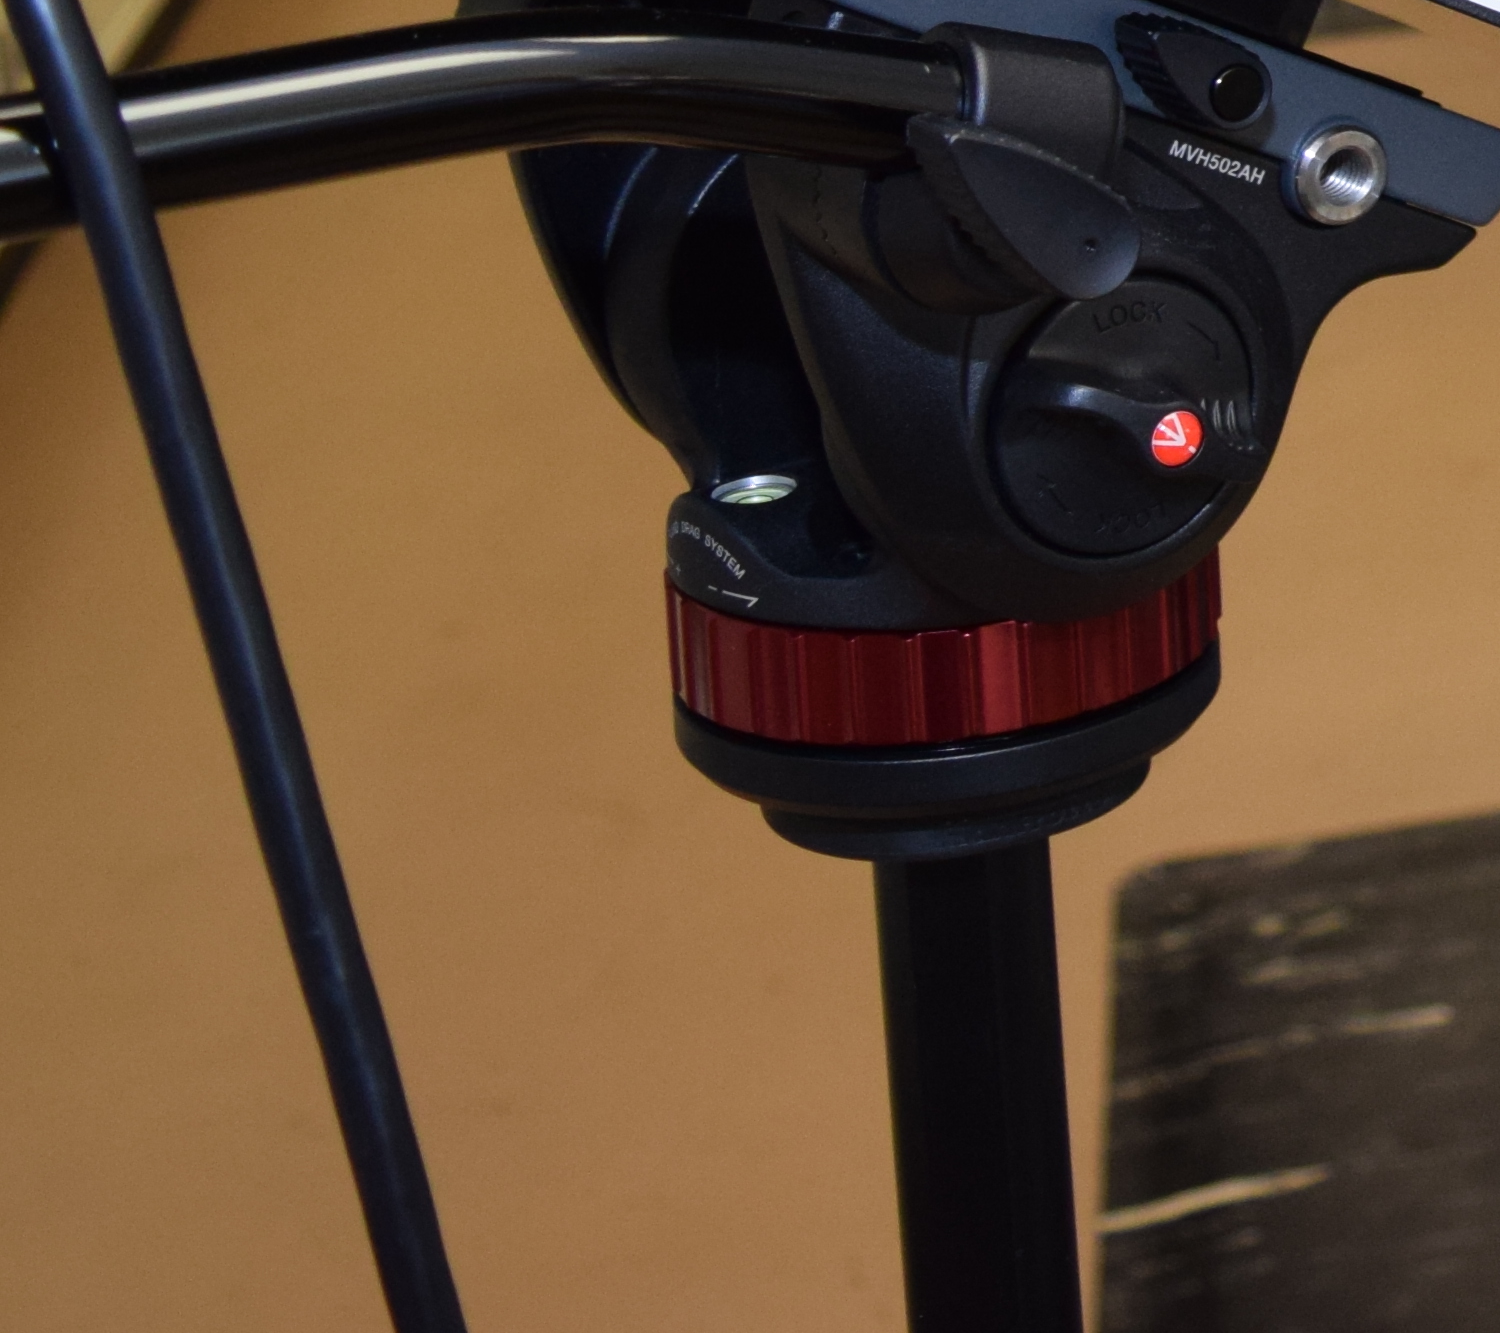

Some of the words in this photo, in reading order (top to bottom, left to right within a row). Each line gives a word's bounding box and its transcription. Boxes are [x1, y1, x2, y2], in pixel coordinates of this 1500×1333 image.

[1168, 140, 1265, 187] MVH502AH
[1092, 300, 1168, 333] LOCK
[681, 521, 701, 540] DRAG
[704, 534, 746, 580] SYSTEM
